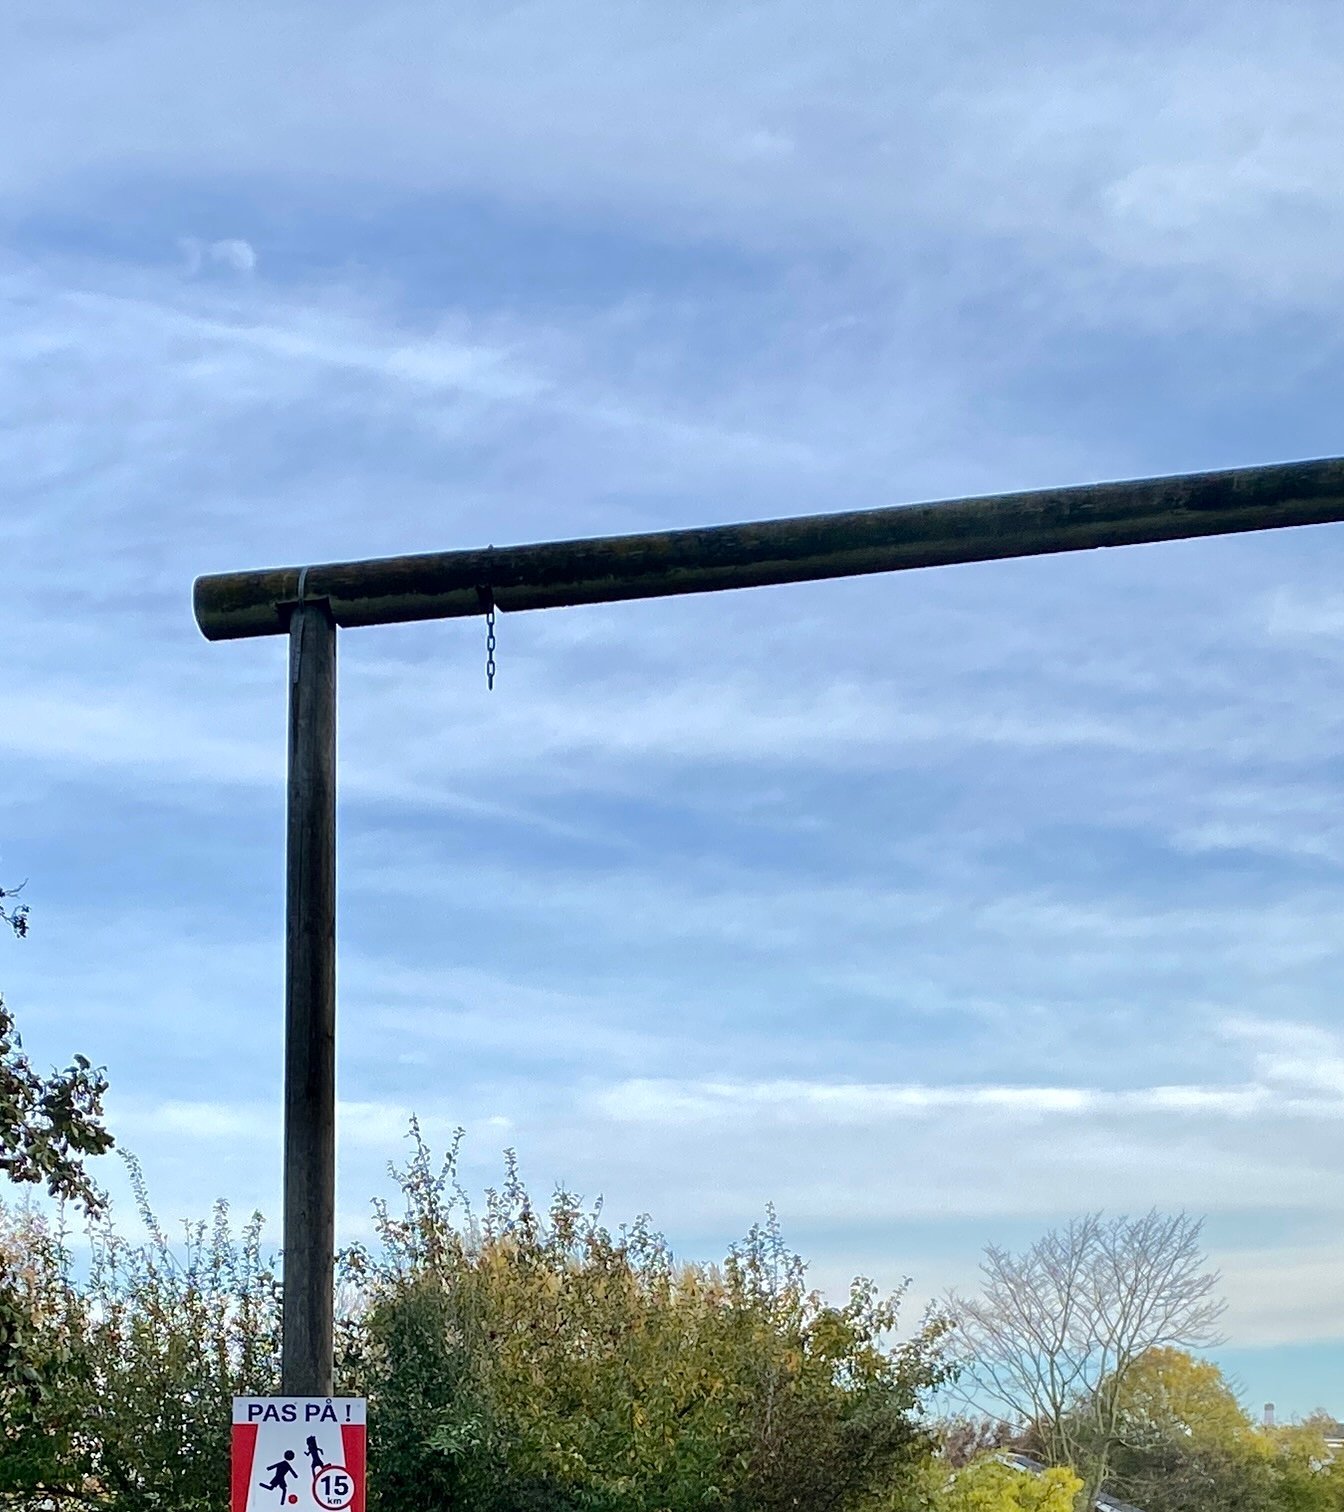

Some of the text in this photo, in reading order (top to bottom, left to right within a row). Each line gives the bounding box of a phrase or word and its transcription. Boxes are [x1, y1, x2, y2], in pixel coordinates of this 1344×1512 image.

[247, 1403, 297, 1422] PAS
[305, 1398, 338, 1422] PÅ
[320, 1475, 349, 1496] 15
[327, 1497, 342, 1505] km
